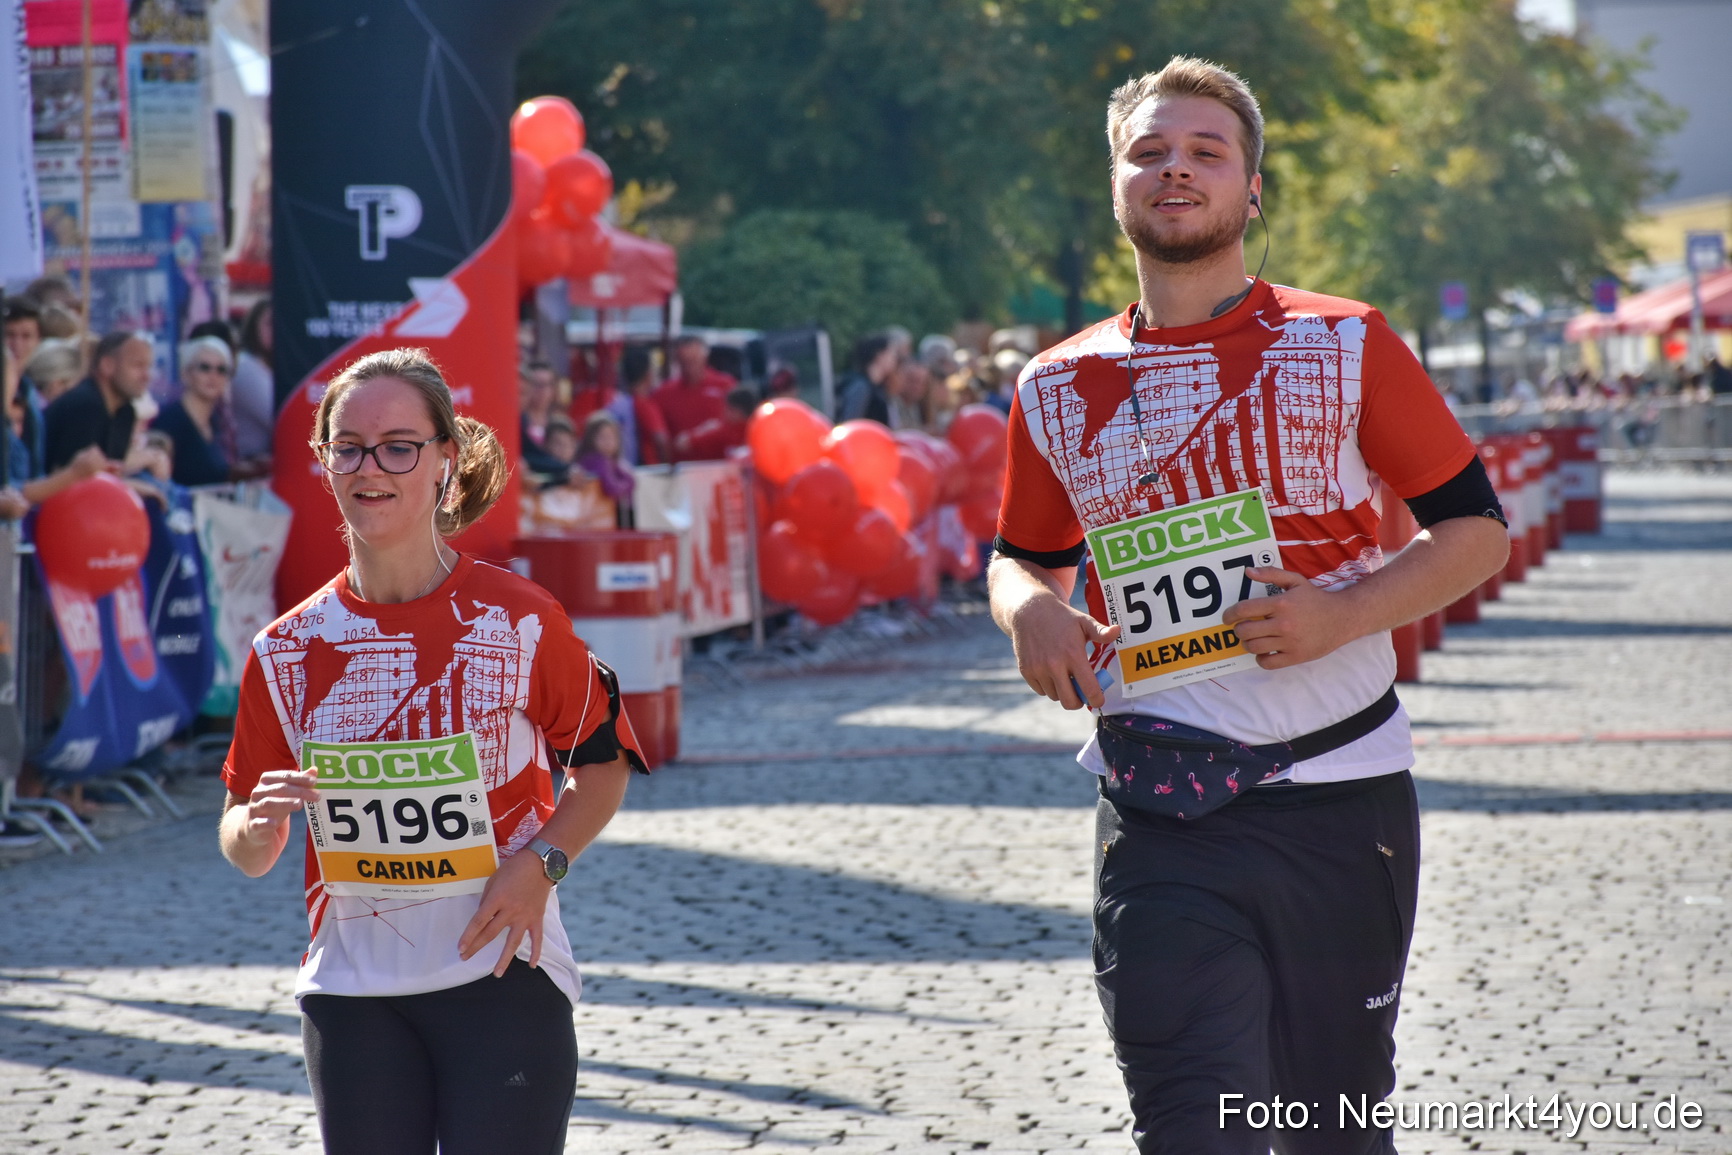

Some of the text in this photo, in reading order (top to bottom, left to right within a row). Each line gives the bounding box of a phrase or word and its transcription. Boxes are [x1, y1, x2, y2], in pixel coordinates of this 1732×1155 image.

[1280, 332, 1338, 345] 91.62%
[1103, 502, 1250, 567] BOCK
[1262, 554, 1271, 564] S
[1122, 553, 1256, 634] 5197
[343, 626, 377, 642] 10.54
[469, 629, 518, 644] 91.62%
[336, 711, 377, 729] 26.22
[312, 746, 460, 781] BOCK
[469, 793, 478, 803] S
[326, 793, 470, 845] 5196
[356, 858, 458, 880] CARINA
[1366, 991, 1395, 1010] JAKO
